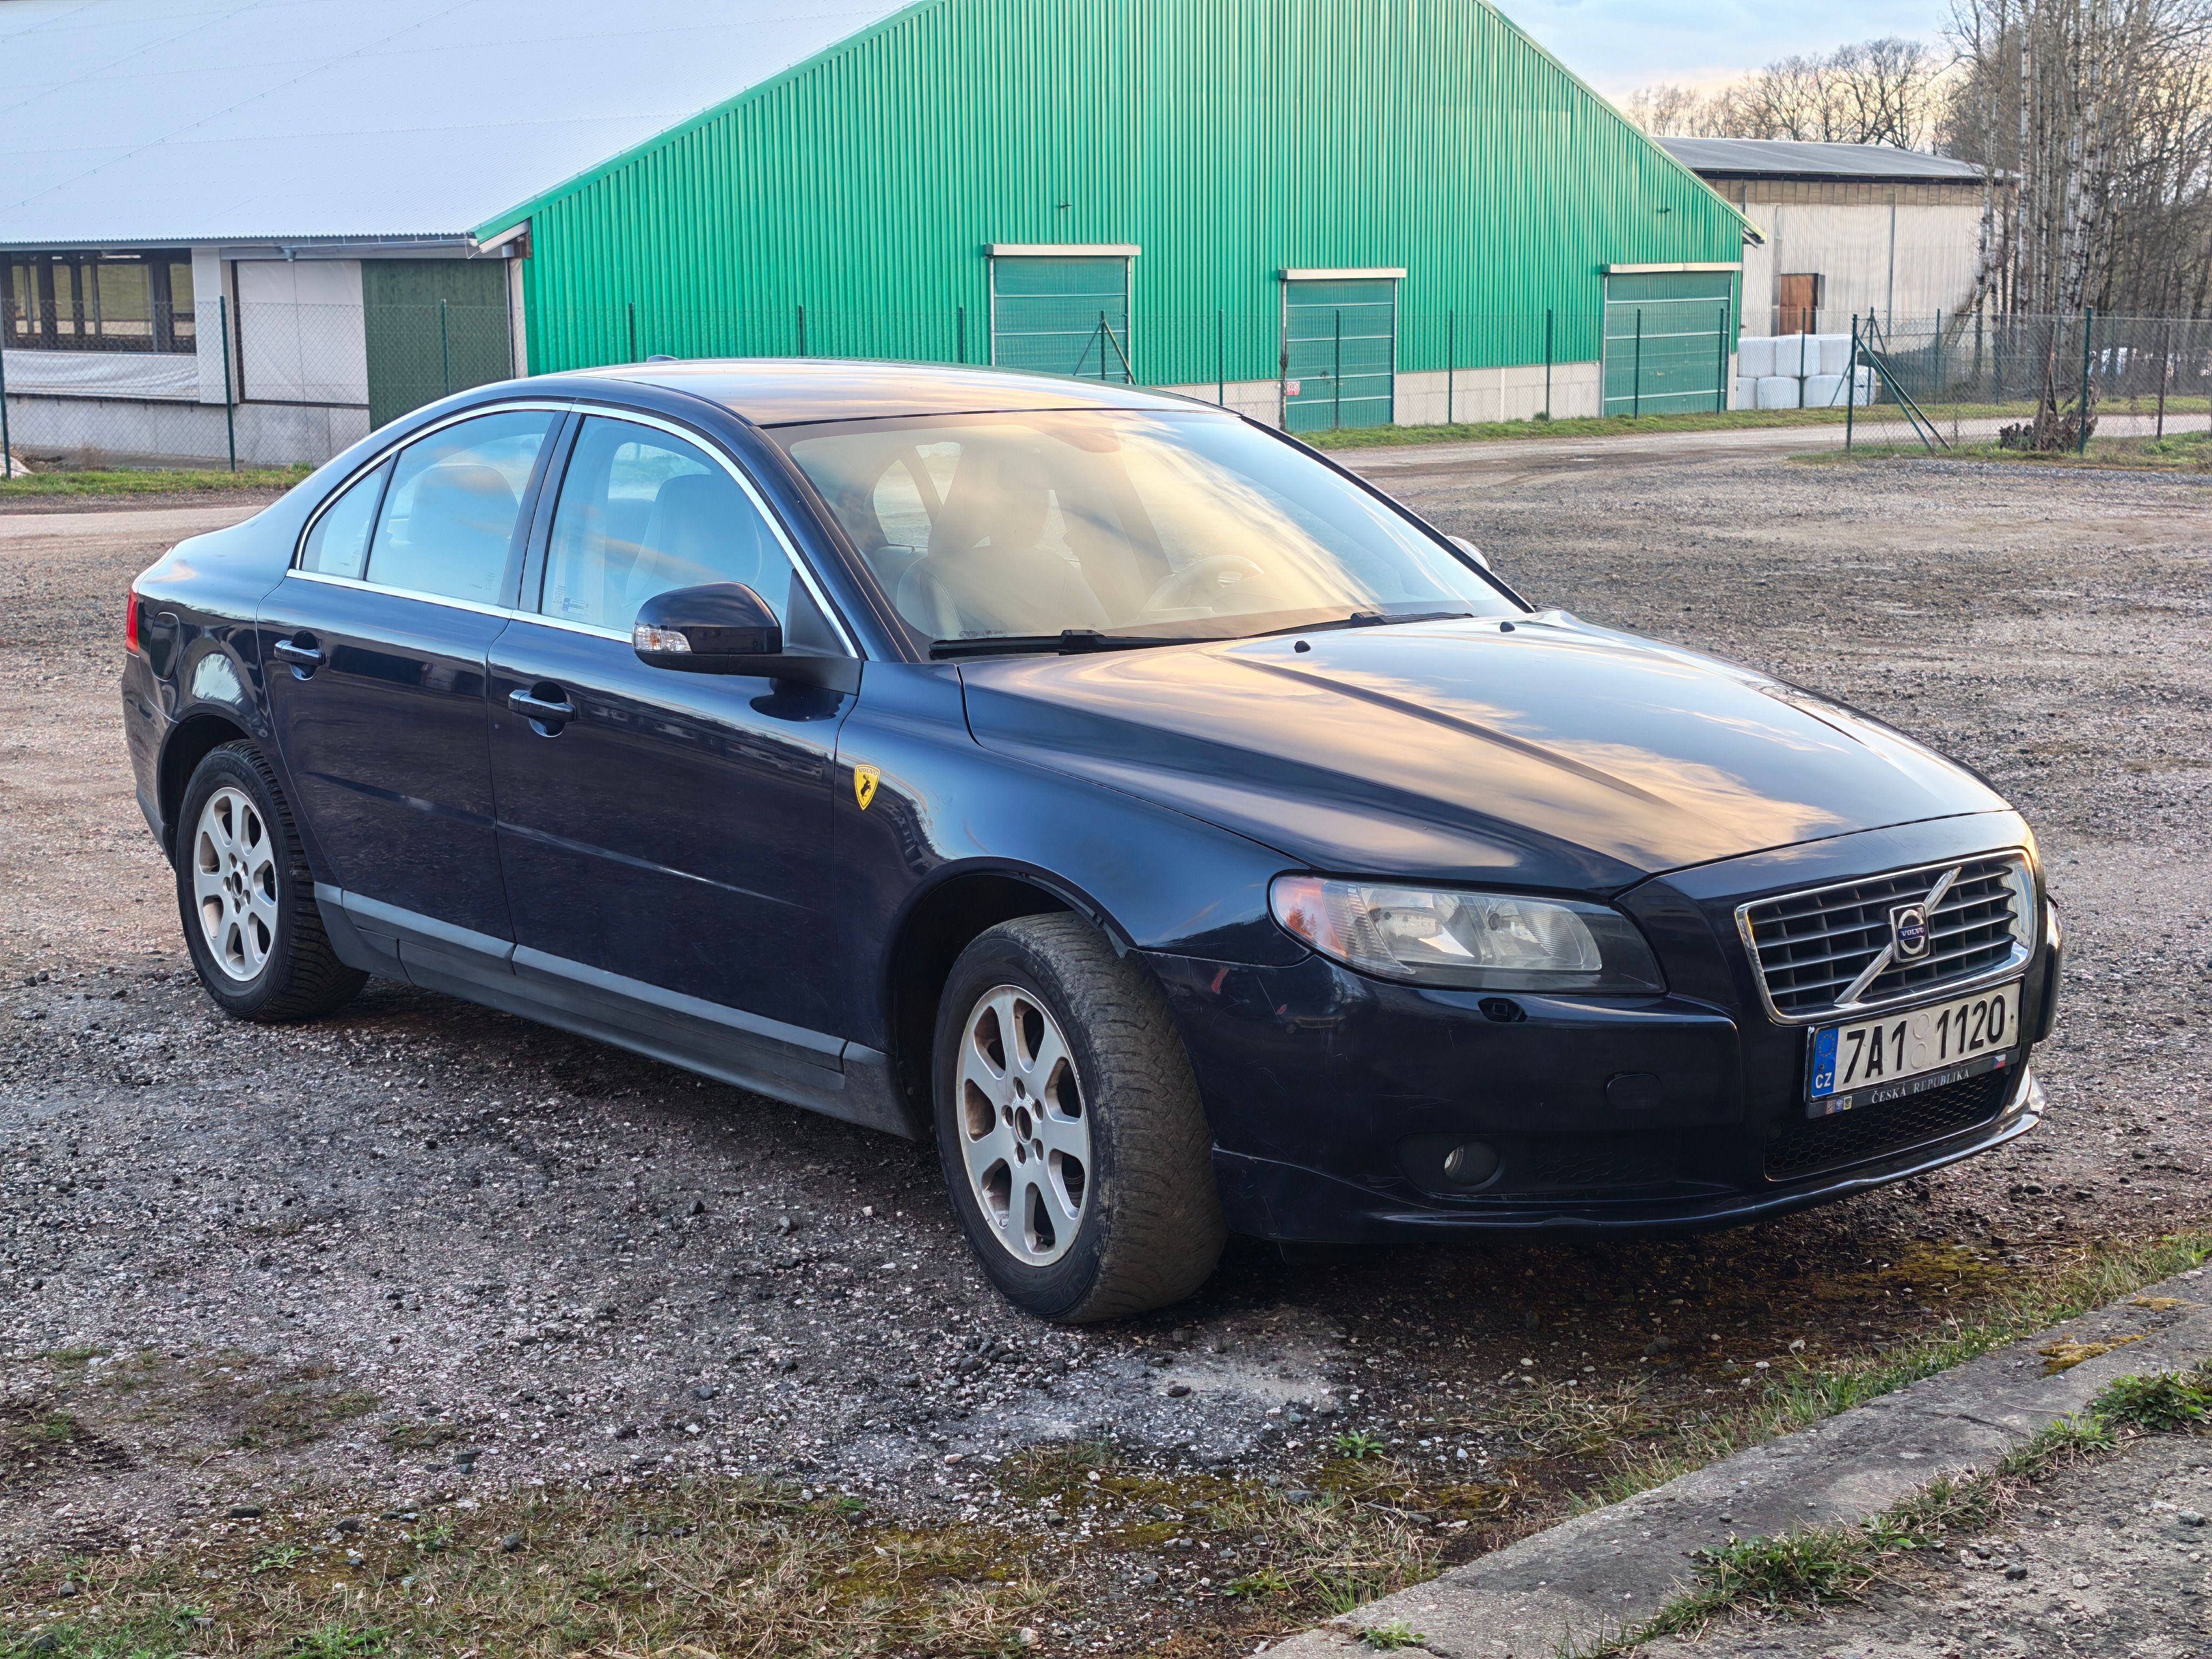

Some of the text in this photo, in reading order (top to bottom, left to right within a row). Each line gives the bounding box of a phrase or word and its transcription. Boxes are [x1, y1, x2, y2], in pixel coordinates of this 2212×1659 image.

[1900, 927, 1925, 937] VOLVO
[1842, 993, 2006, 1084] 7A1 1120
[1815, 1072, 1832, 1089] CZ
[1872, 1067, 1970, 1104] ČESKÁ REPUBLIKA
